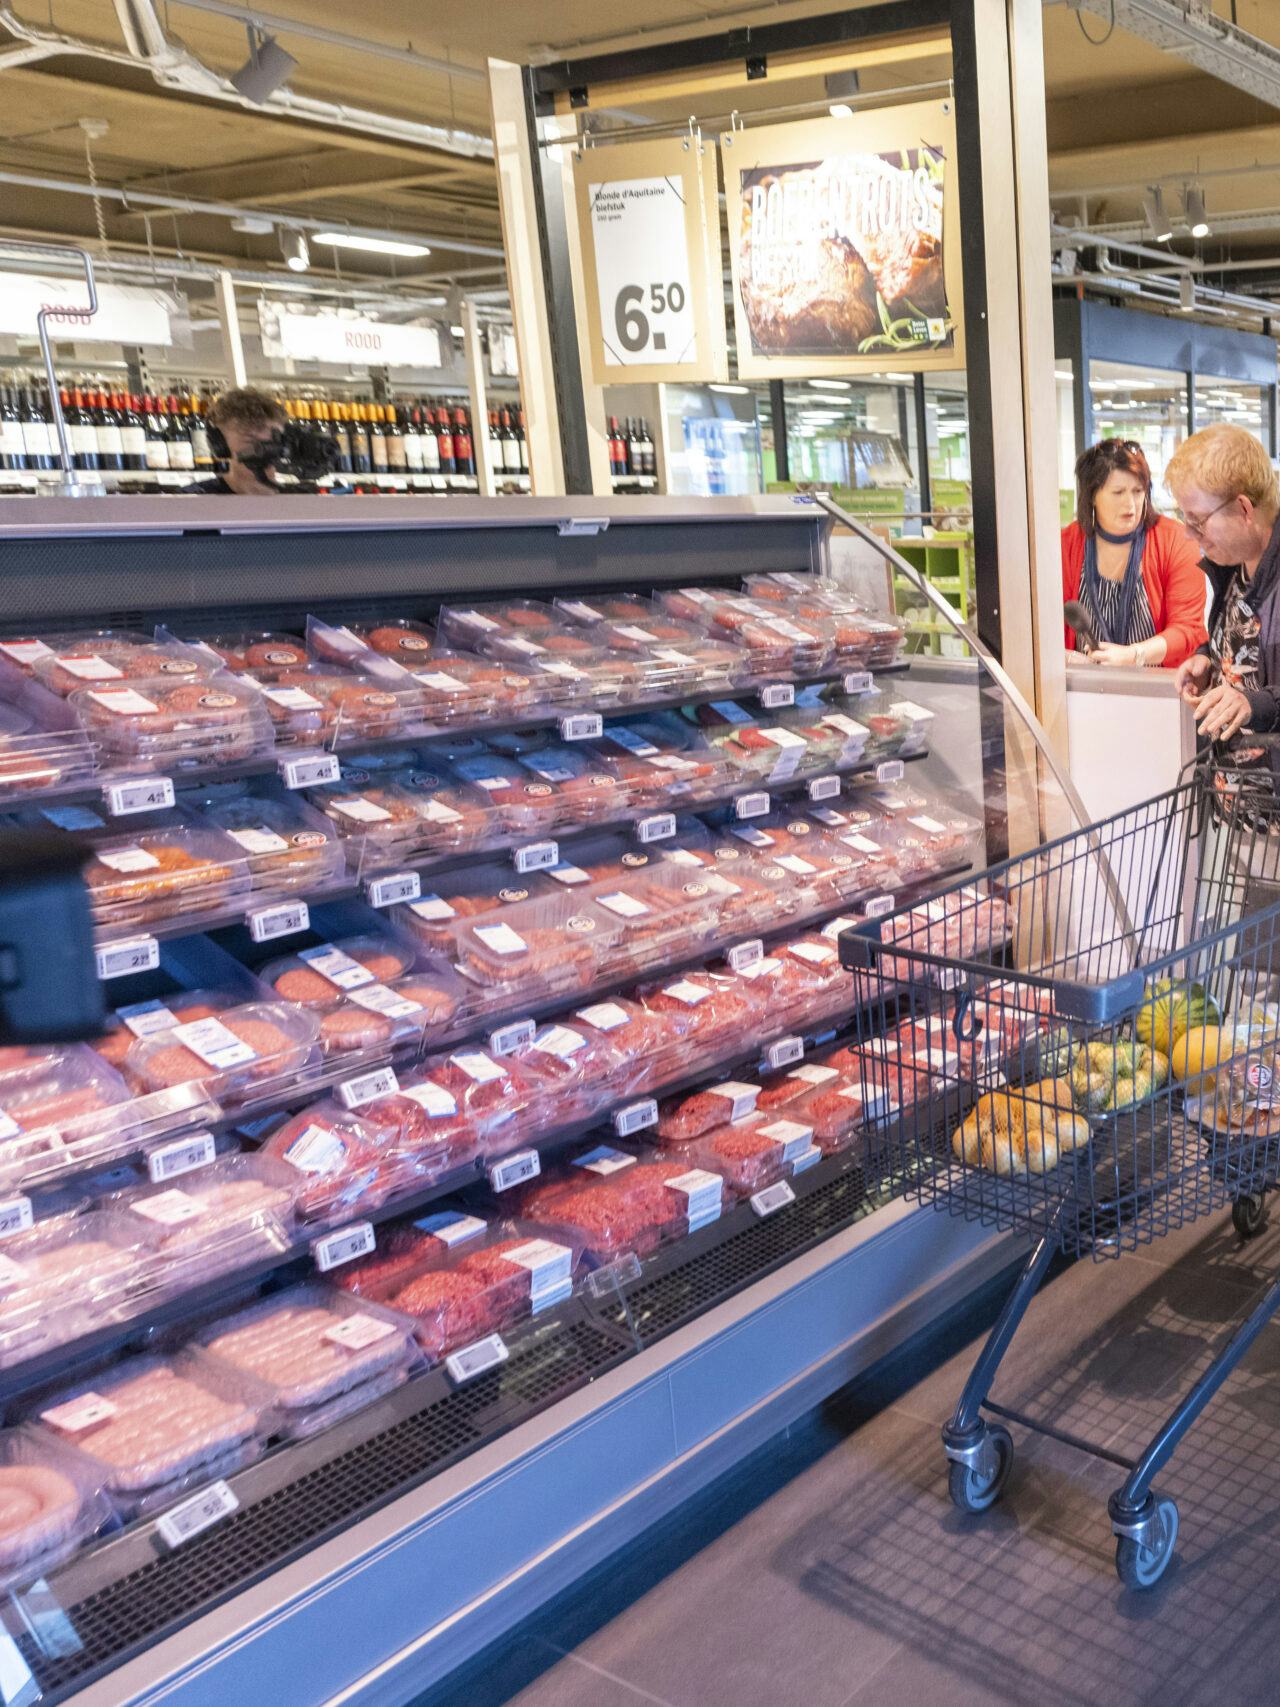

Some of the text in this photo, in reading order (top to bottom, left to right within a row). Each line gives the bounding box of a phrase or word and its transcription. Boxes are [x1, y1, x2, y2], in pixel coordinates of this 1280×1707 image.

[622, 188, 665, 199] d'Aquitaine
[596, 202, 626, 212] biefstuk
[345, 331, 382, 350] ROOD
